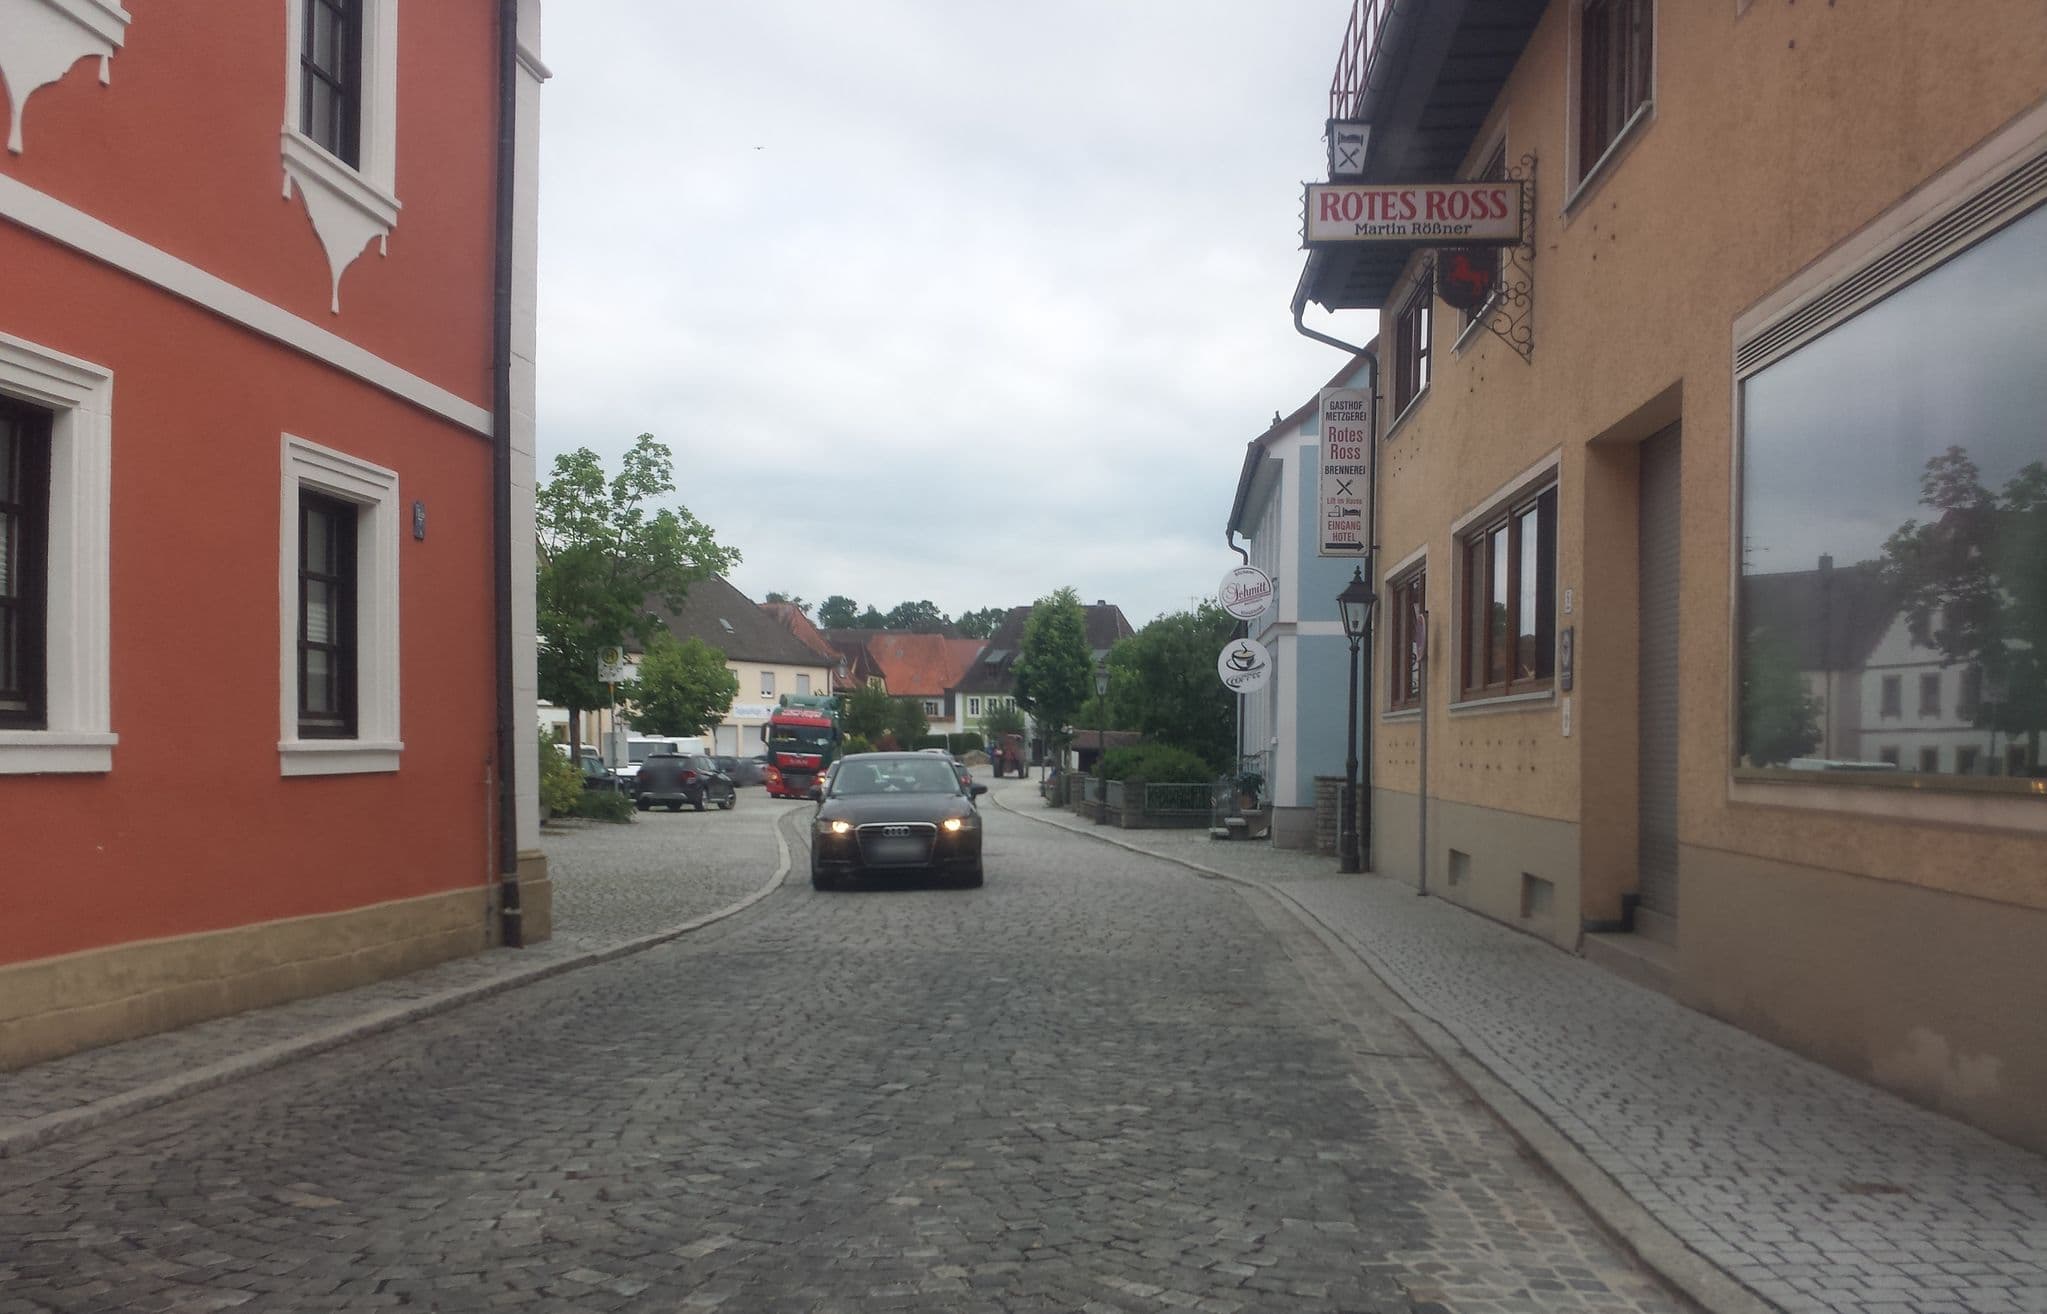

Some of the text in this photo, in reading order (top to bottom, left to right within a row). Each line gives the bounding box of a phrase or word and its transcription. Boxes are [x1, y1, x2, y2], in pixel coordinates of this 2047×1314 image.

[1320, 190, 1508, 222] ROTES ROSS
[1355, 221, 1472, 236] Martin Rößner
[1329, 400, 1363, 411] GASTHOF
[1325, 412, 1367, 422] METZGEREI
[1328, 426, 1363, 443] Rotes
[1330, 444, 1361, 460] Ross
[1325, 465, 1366, 475] BRENNEREI
[1328, 520, 1361, 531] EINGANG
[1332, 531, 1356, 542] HOTEL
